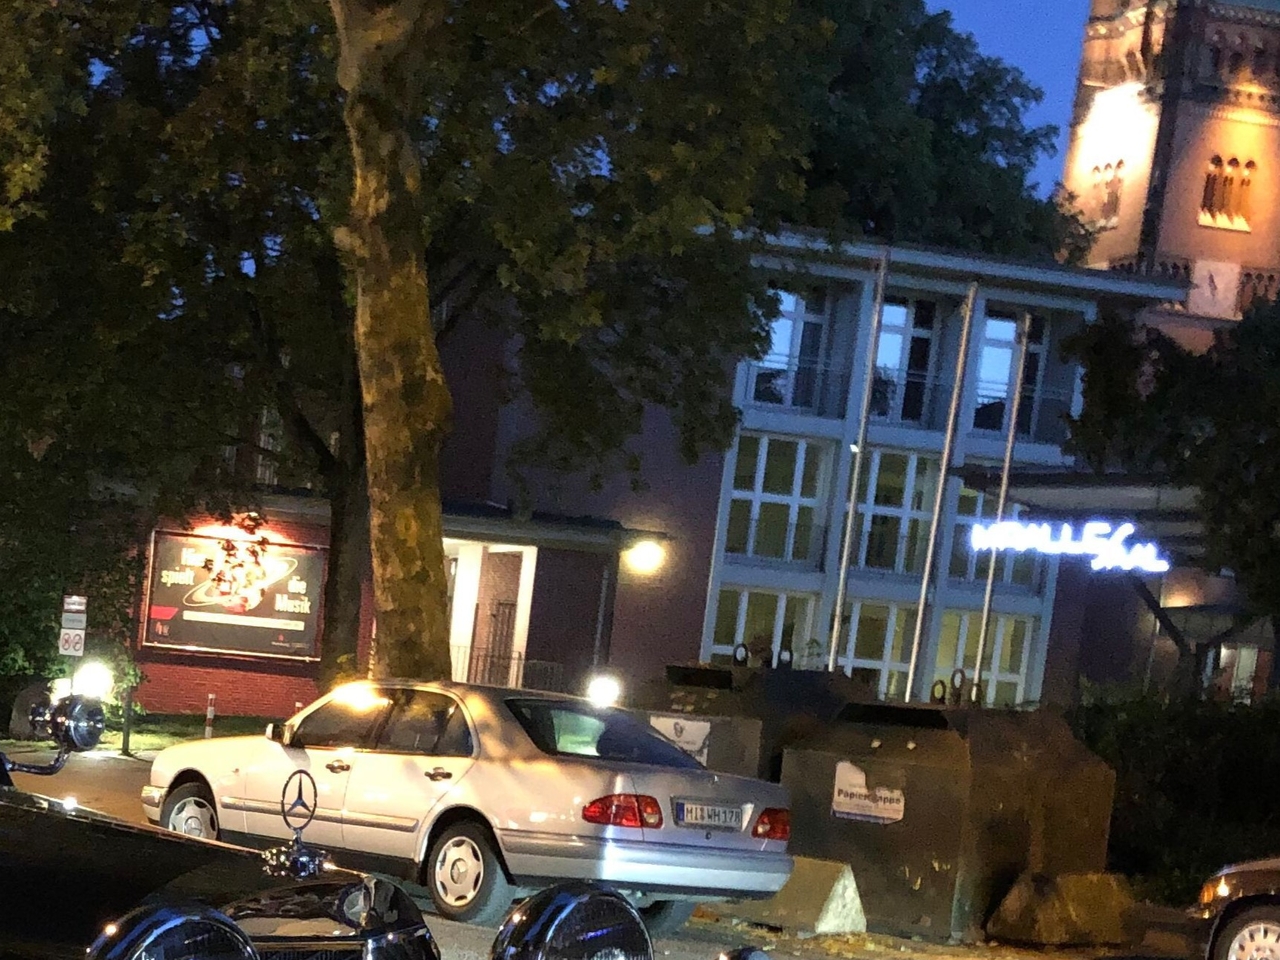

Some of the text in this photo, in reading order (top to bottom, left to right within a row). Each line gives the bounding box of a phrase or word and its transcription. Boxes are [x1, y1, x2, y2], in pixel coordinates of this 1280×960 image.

[161, 567, 195, 587] spielt
[287, 575, 307, 594] die
[275, 593, 311, 614] Musik
